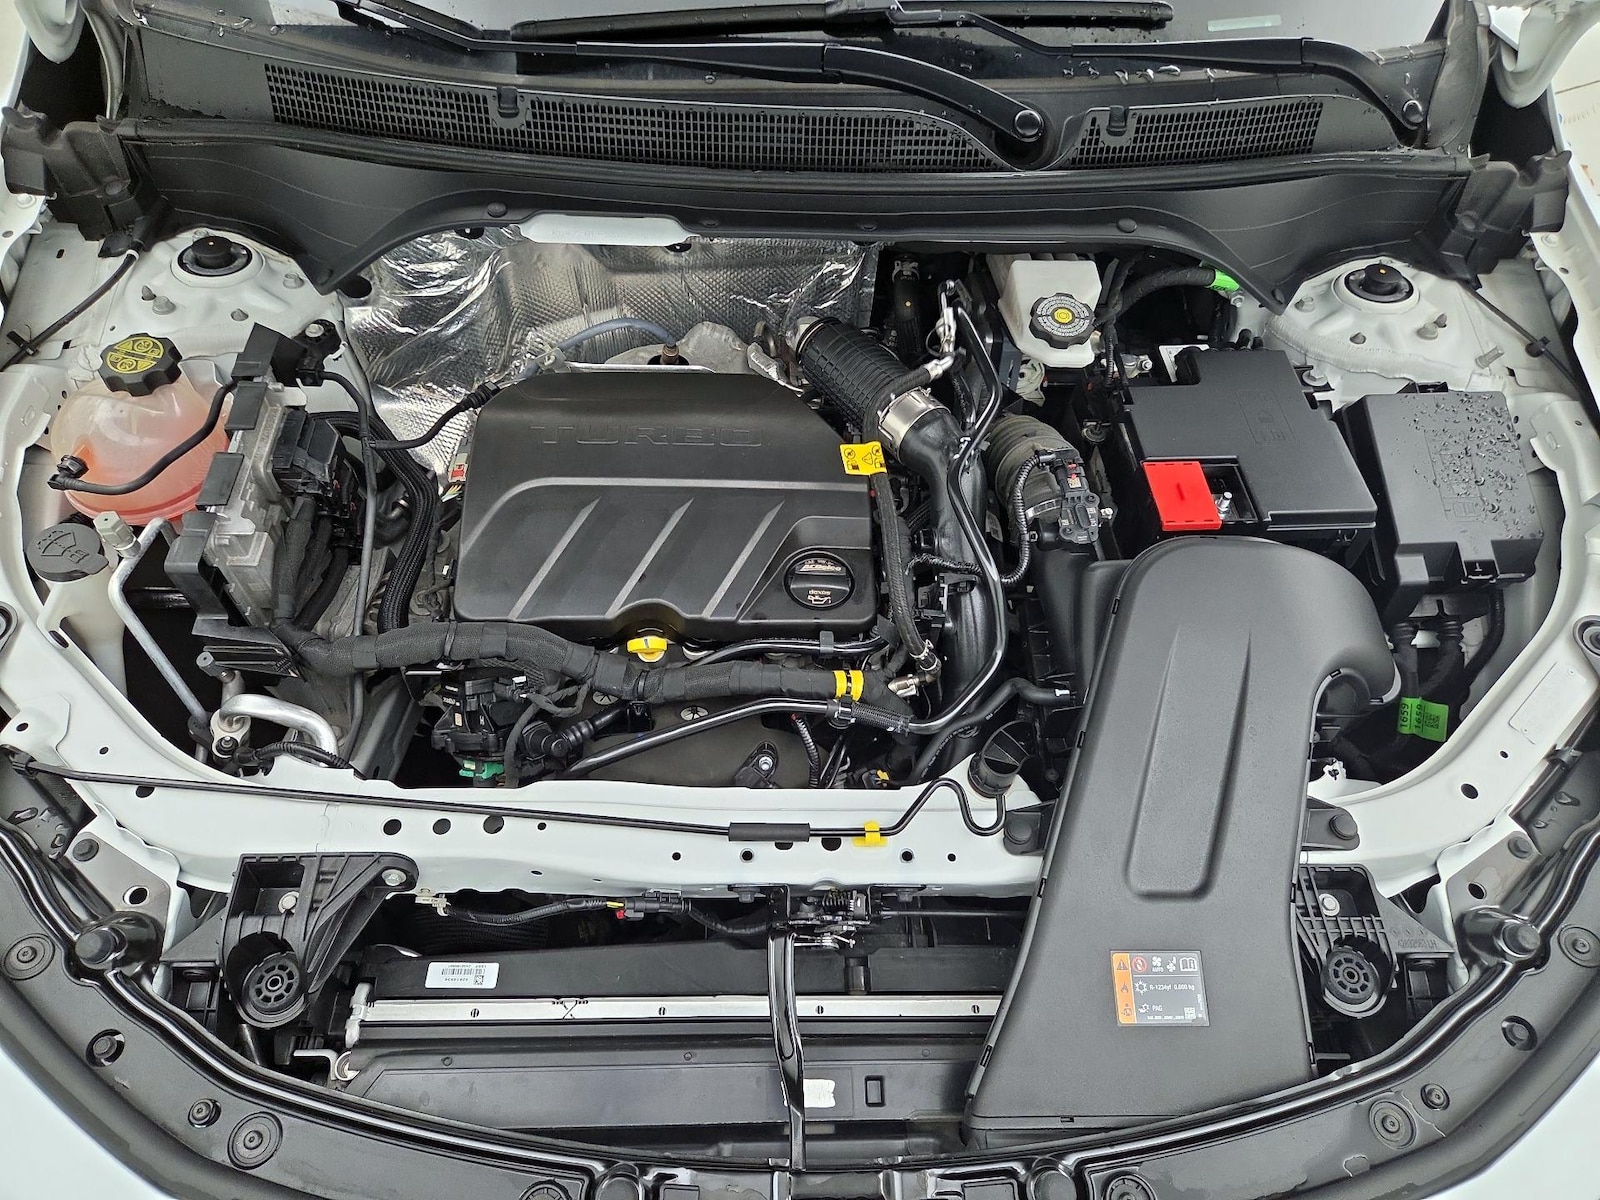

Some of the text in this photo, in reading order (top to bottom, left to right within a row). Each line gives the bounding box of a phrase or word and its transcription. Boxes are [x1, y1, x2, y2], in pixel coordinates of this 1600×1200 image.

[530, 425, 762, 447] TURBO
[1400, 703, 1409, 728] 1659
[1414, 703, 1422, 729] 1659
